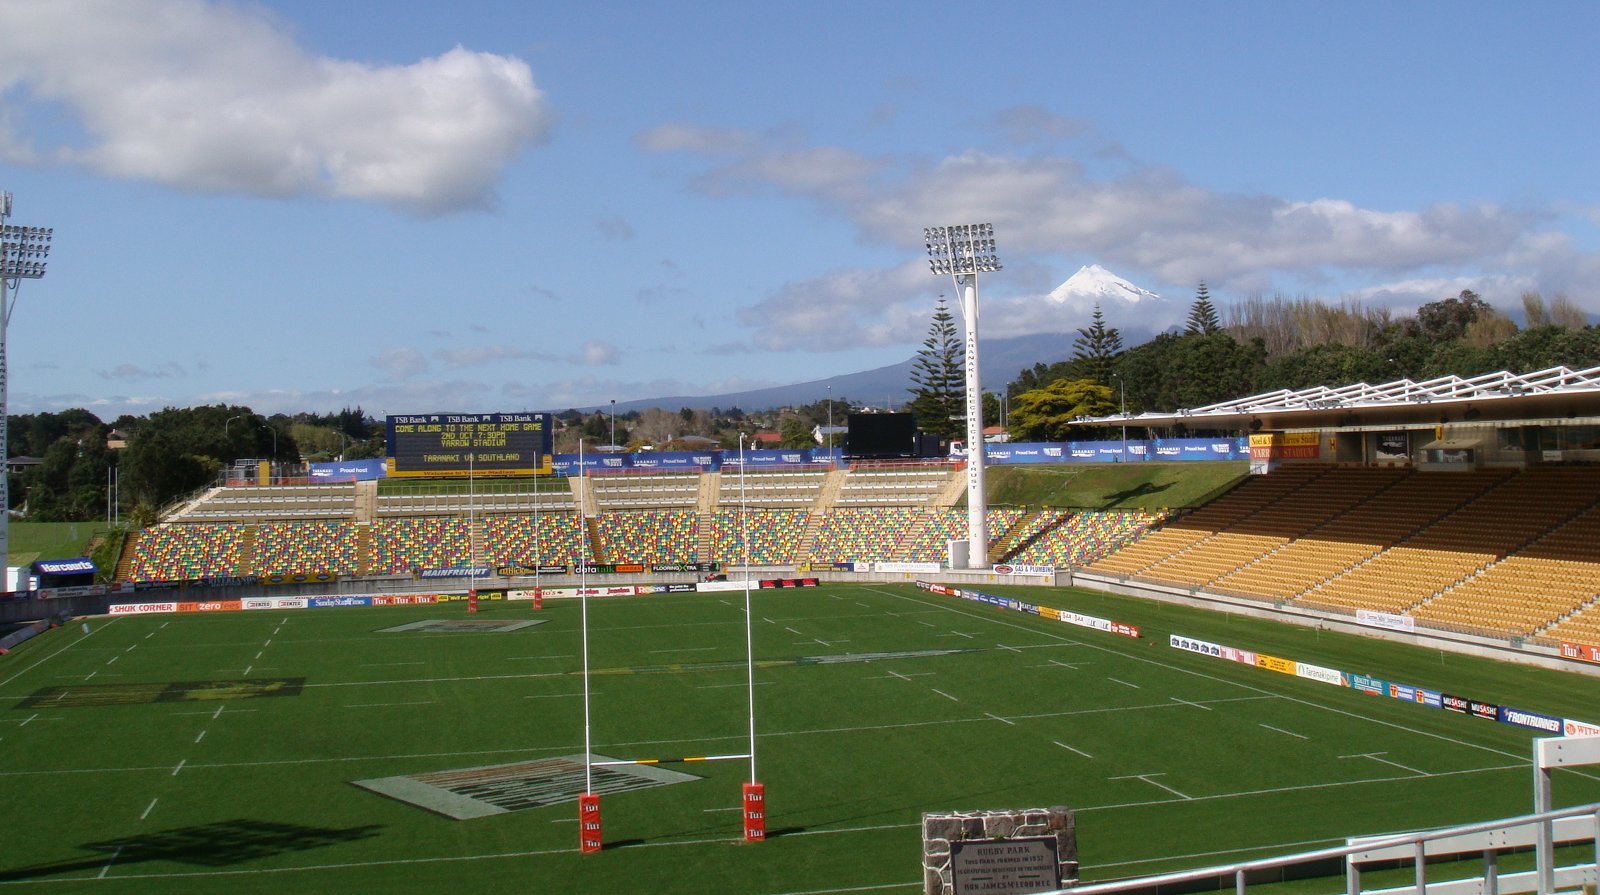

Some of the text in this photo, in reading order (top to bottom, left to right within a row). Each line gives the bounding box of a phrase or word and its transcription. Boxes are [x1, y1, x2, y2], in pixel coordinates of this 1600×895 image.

[1284, 448, 1314, 457] STADIUM
[40, 560, 93, 572] Harcourts
[422, 568, 488, 576] MAINFREIGHT
[1563, 644, 1577, 657] Tui
[1443, 697, 1467, 708] MUSASHI
[1471, 703, 1497, 715] MUSASHI
[1507, 711, 1559, 732] FRONTRUNNER
